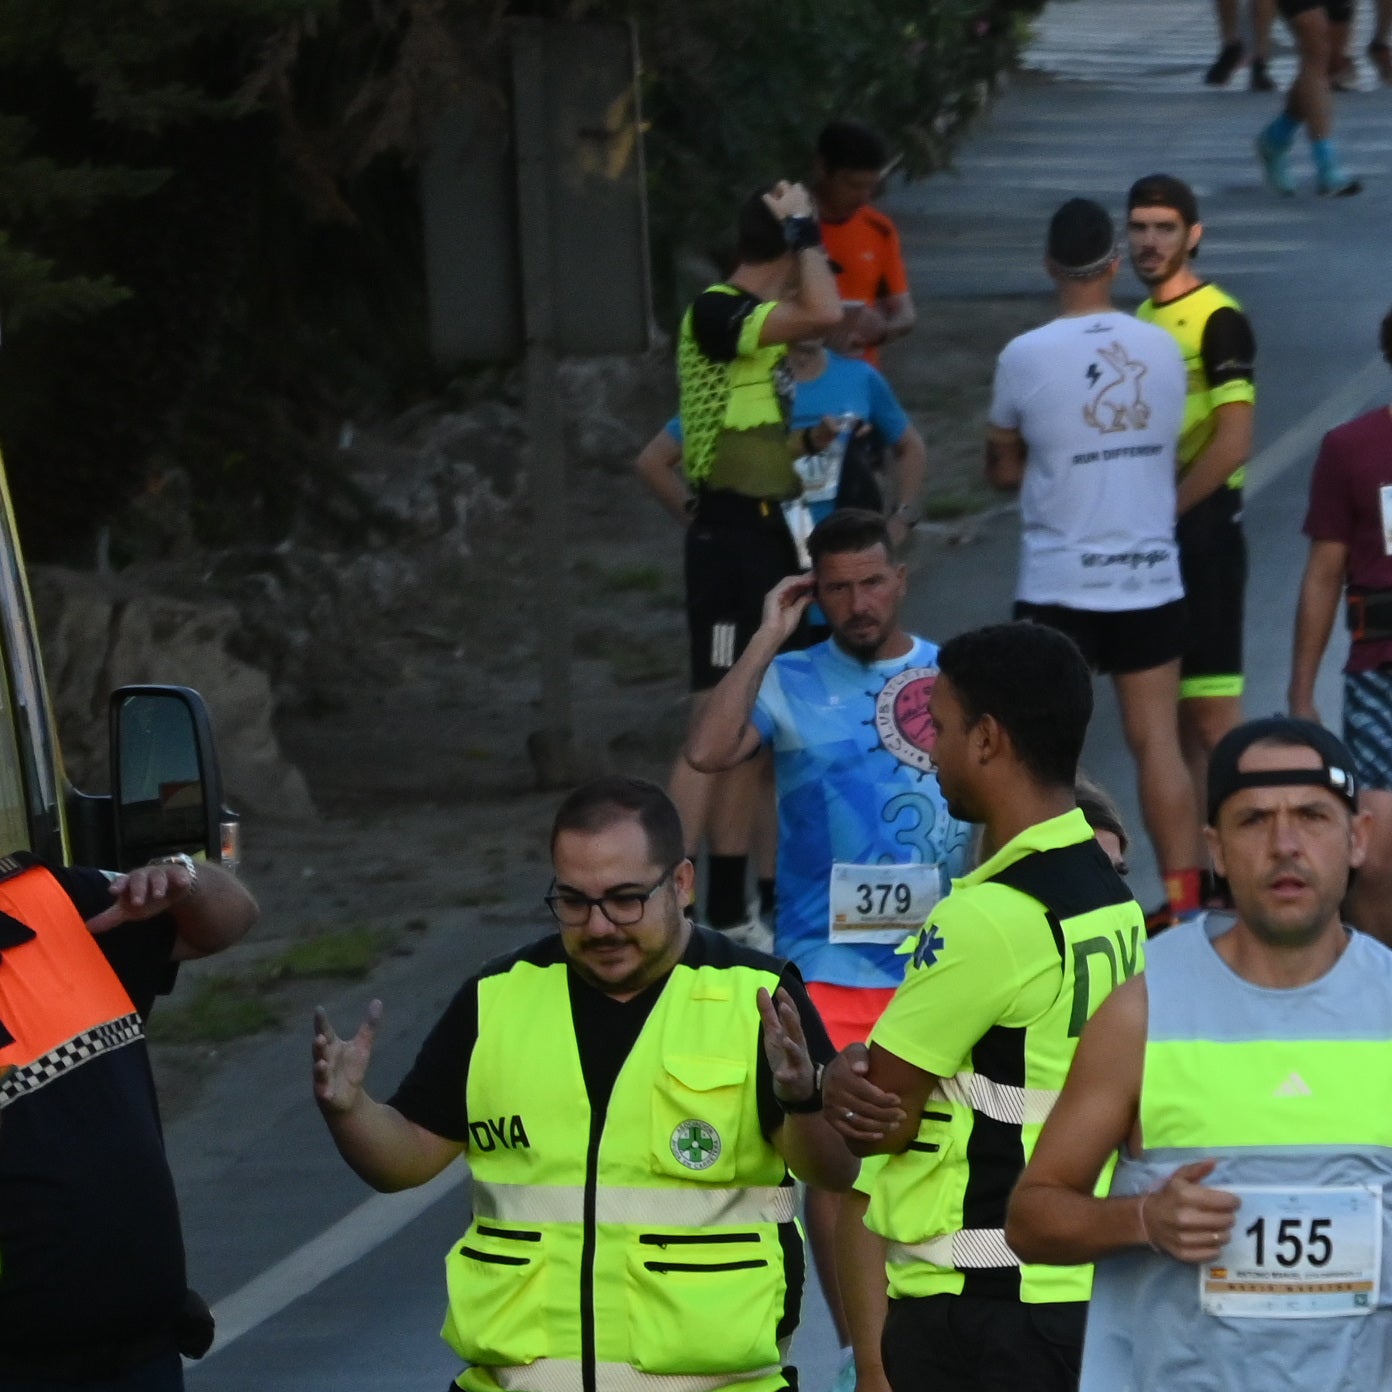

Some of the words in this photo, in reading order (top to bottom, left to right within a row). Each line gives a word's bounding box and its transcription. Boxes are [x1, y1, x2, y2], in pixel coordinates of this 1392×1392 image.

[856, 883, 912, 915] 379
[470, 1115, 531, 1152] DYA
[1246, 1216, 1333, 1268] 155
